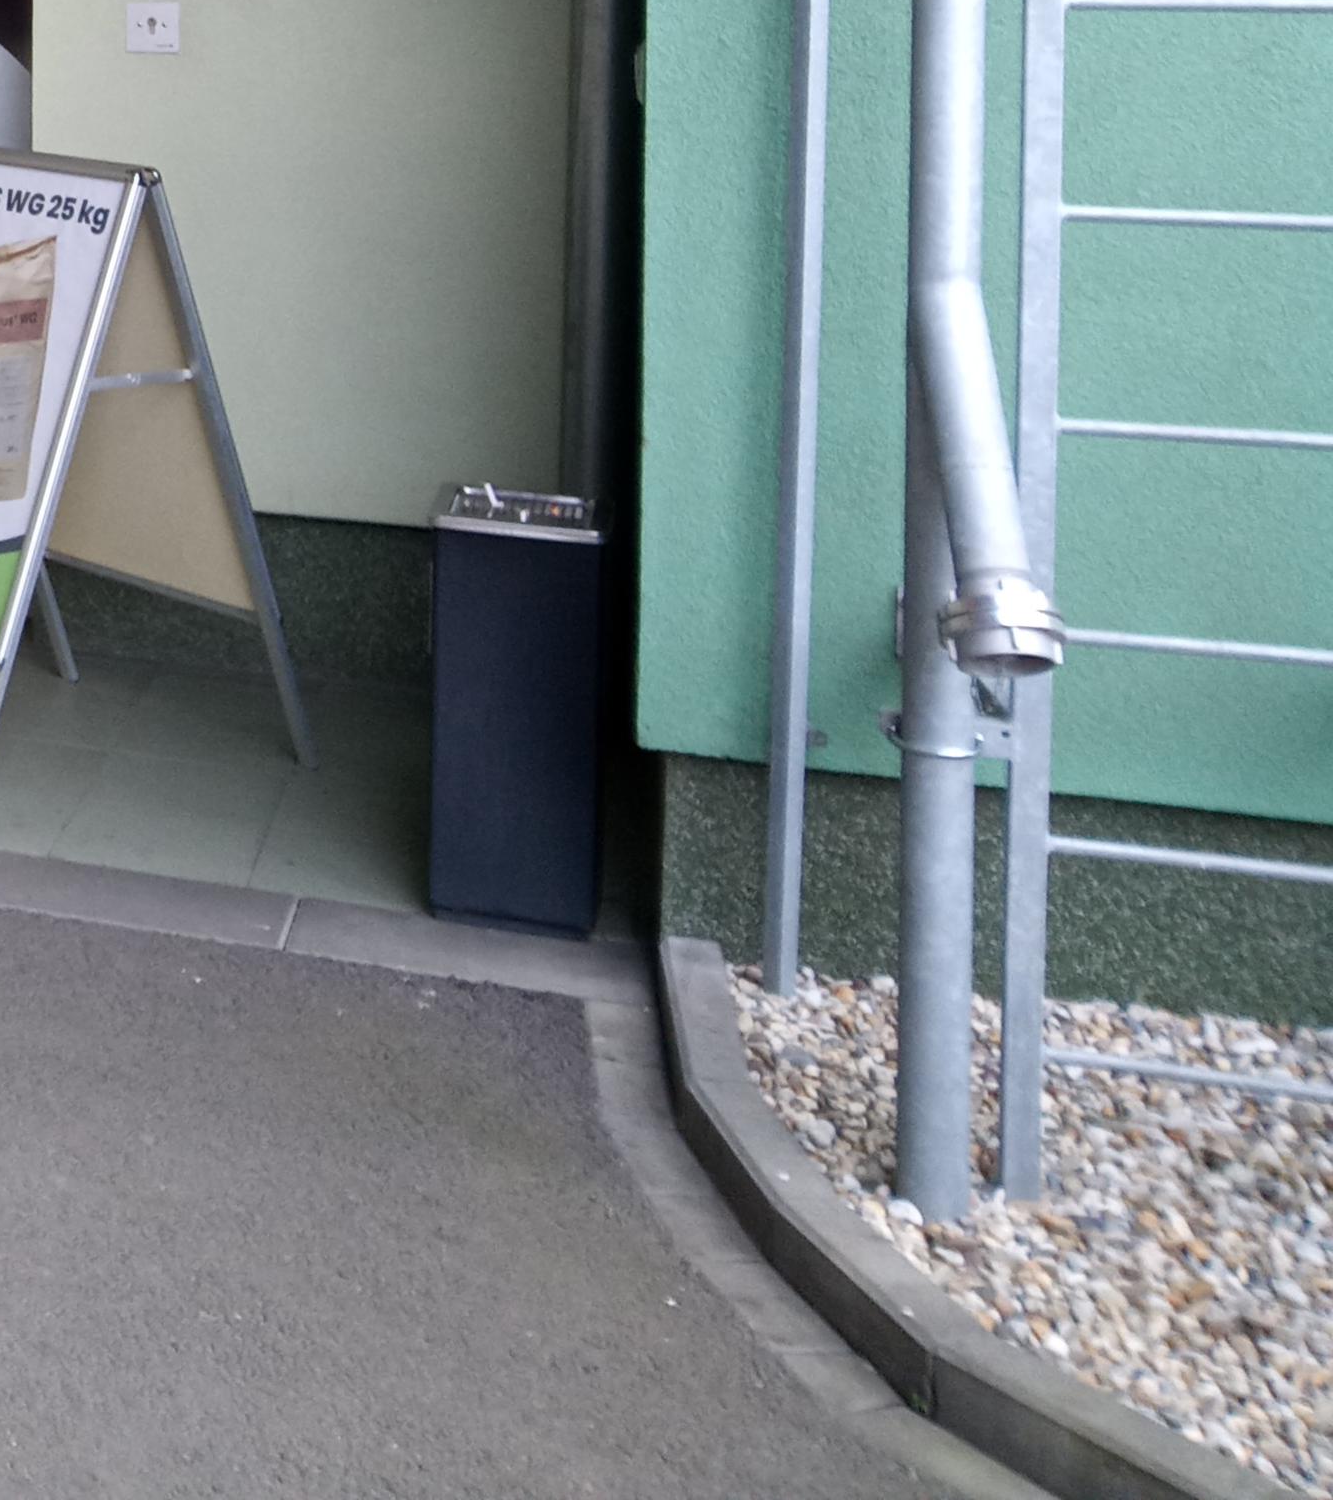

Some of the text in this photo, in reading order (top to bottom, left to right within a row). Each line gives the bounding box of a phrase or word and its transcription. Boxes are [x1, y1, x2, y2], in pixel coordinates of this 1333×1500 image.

[6, 188, 45, 217] WG
[46, 194, 77, 222] 25
[79, 199, 110, 235] kg
